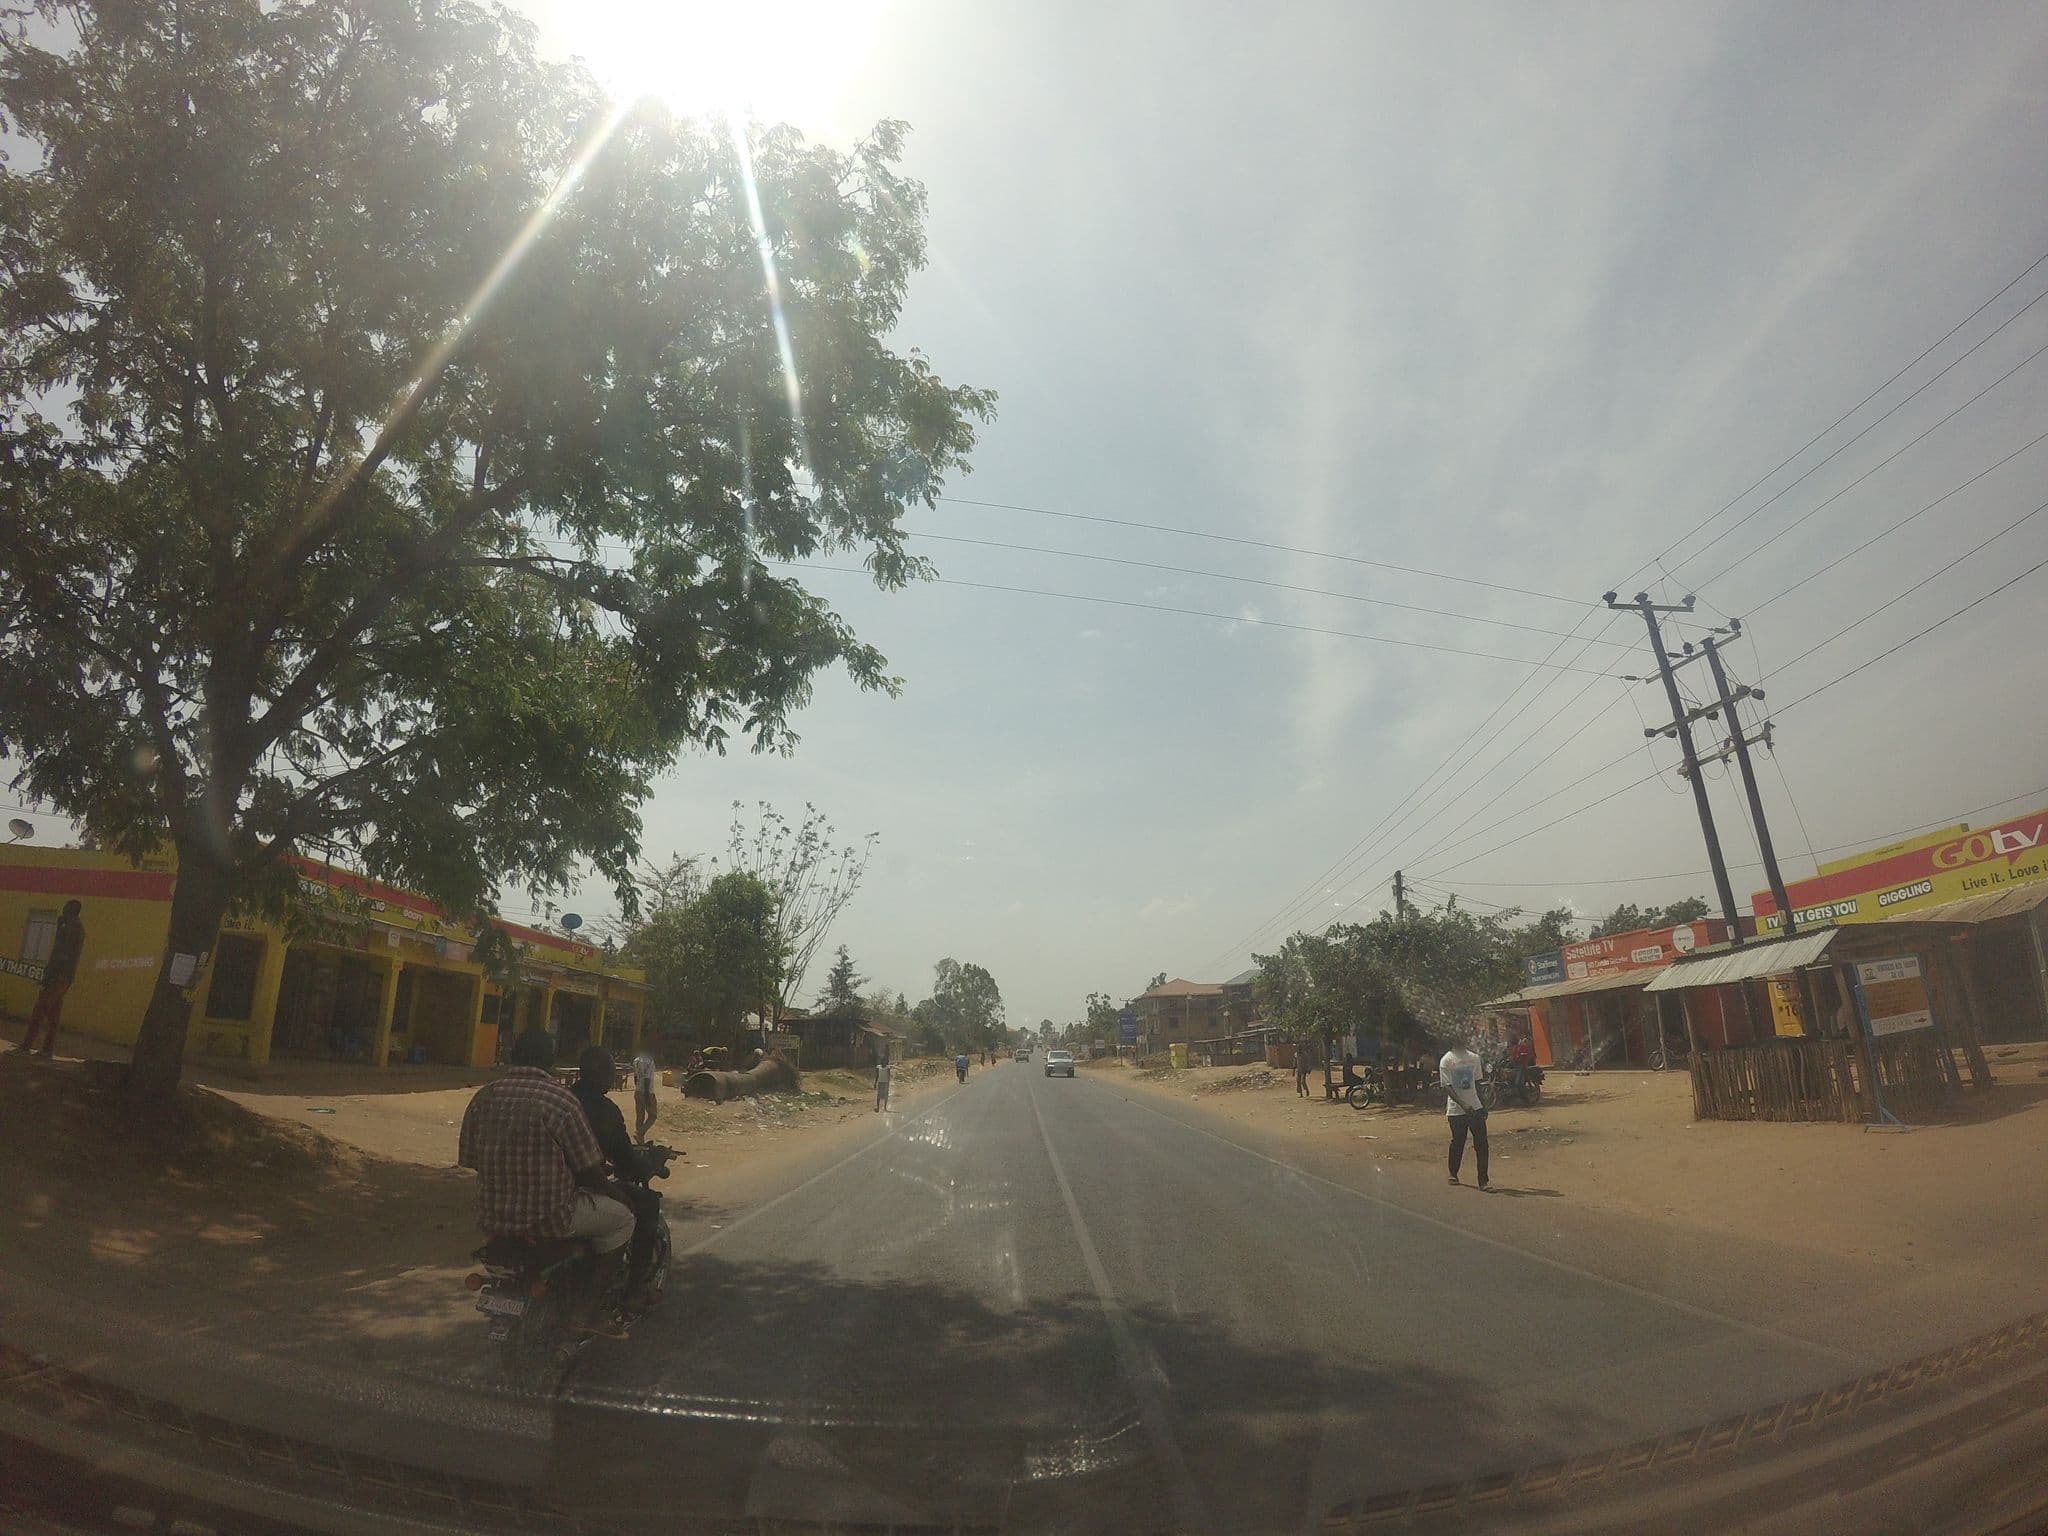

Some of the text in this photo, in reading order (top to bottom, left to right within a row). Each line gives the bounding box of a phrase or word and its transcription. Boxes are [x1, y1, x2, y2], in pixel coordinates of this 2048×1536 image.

[1962, 876, 1988, 891] Live
[1991, 873, 2005, 884] it.
[2008, 864, 2039, 880] Love
[1879, 881, 1932, 906] GIGGLING
[1766, 916, 1779, 929] TV
[1806, 905, 1832, 922] GETS
[1833, 900, 1857, 917] YOU
[1566, 940, 1614, 960] Satellite TV
[7, 959, 28, 976] THAT
